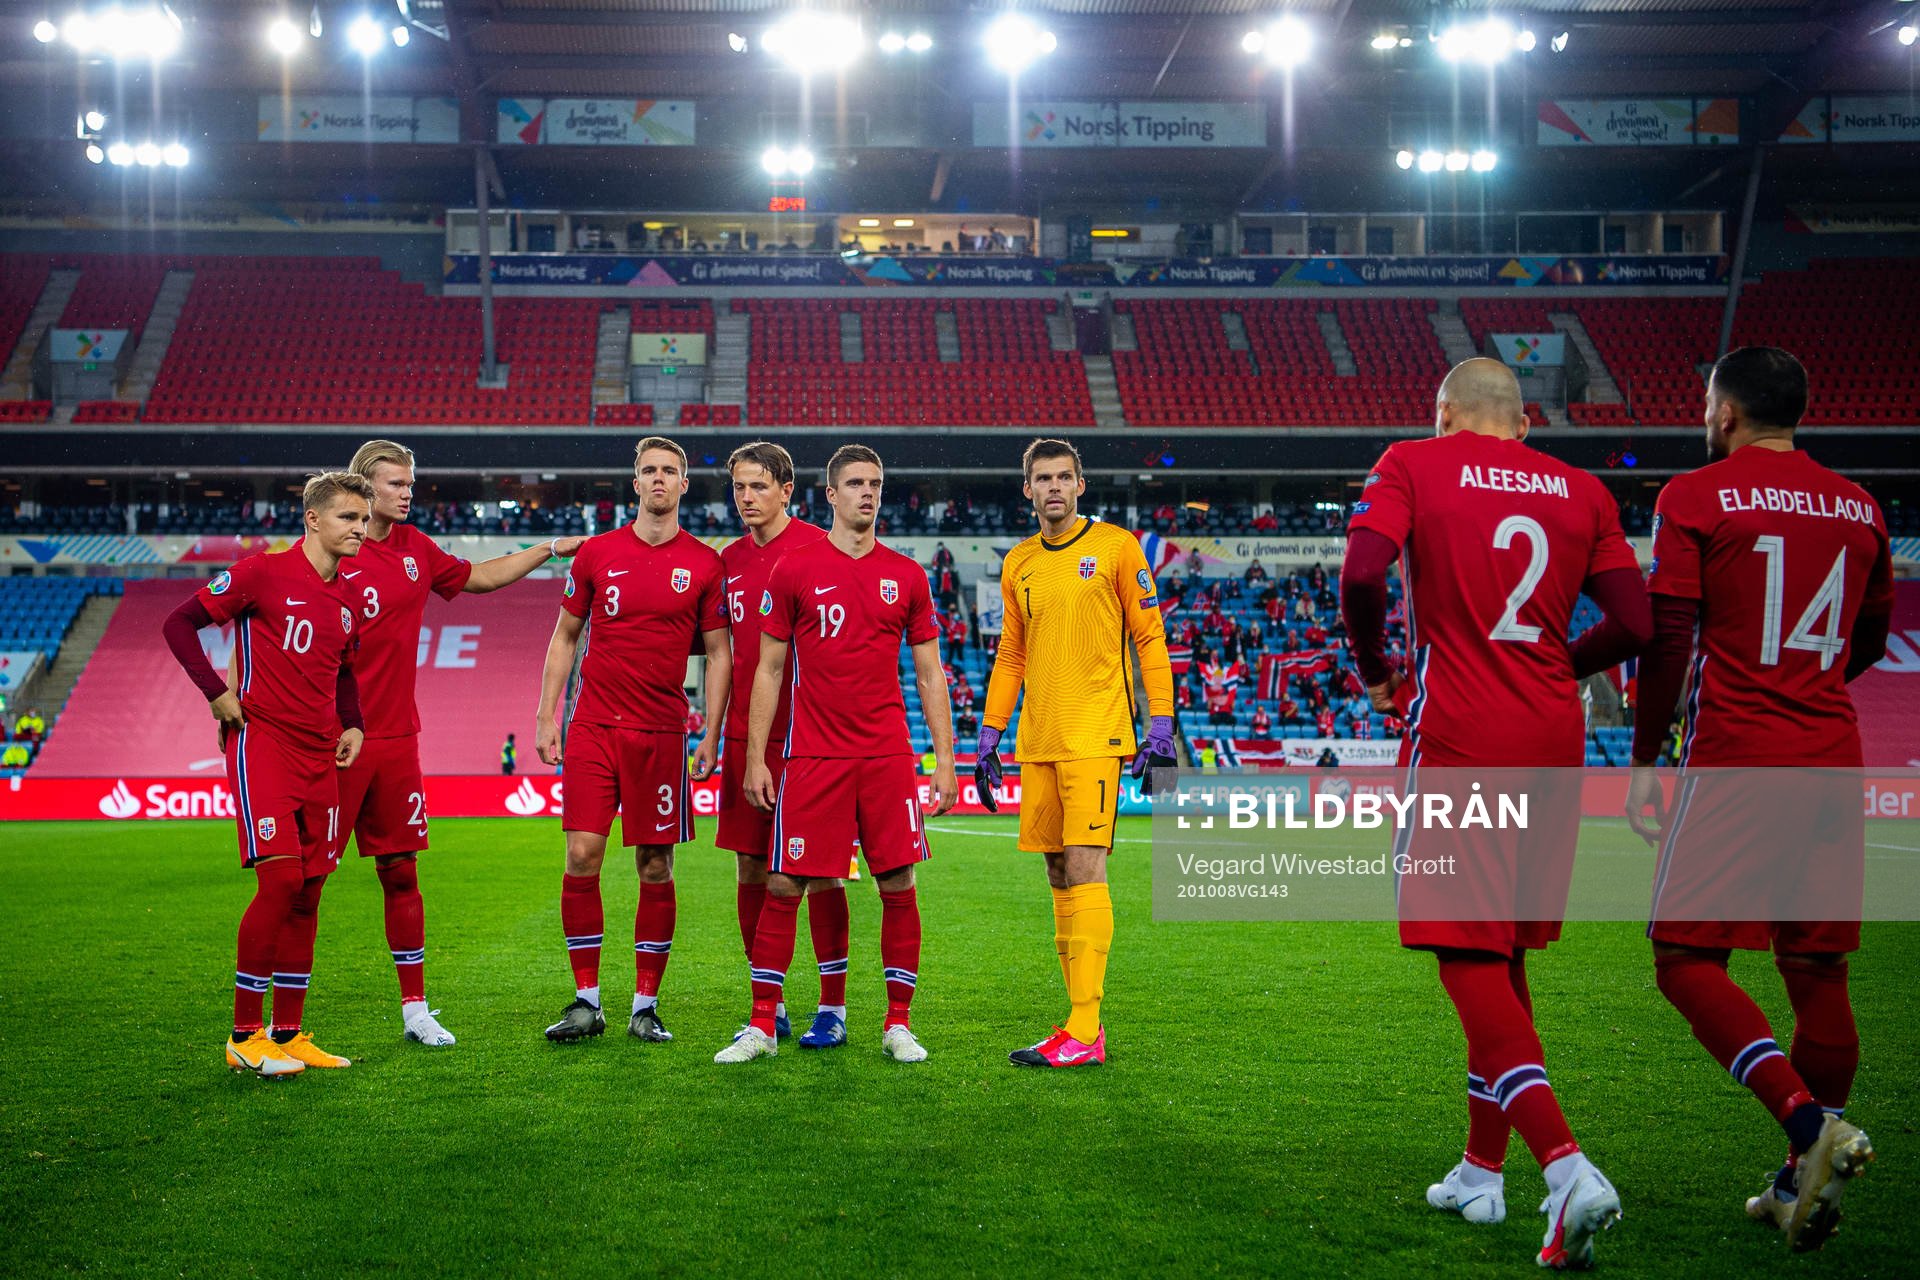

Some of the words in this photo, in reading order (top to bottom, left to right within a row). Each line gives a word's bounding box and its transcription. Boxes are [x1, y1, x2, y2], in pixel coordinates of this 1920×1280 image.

[323, 114, 364, 127] Norsk
[369, 114, 420, 132] Tipping
[1065, 116, 1129, 136] Norsk
[1132, 116, 1214, 141] Tipping
[1844, 114, 1886, 127] Norsk
[500, 264, 537, 277] Norsk
[538, 264, 587, 280] Tipping
[947, 266, 984, 278] Norsk
[986, 266, 1033, 281] Tipping
[1170, 267, 1207, 280] Norsk
[1209, 267, 1256, 282] Tipping
[1619, 265, 1656, 278] Norsk
[1658, 265, 1706, 280] Tipping
[1460, 465, 1569, 499] ALEESAMI
[1236, 542, 1249, 557] Gi
[1488, 515, 1549, 643] 2
[605, 587, 619, 616] 3
[1024, 588, 1033, 619] 1
[1752, 535, 1847, 671] 14
[282, 615, 313, 654] 10
[817, 604, 846, 638] 19
[657, 784, 673, 816] 3
[1098, 779, 1105, 814] 1
[1189, 786, 1246, 804] EURO
[1250, 786, 1302, 804] 2020
